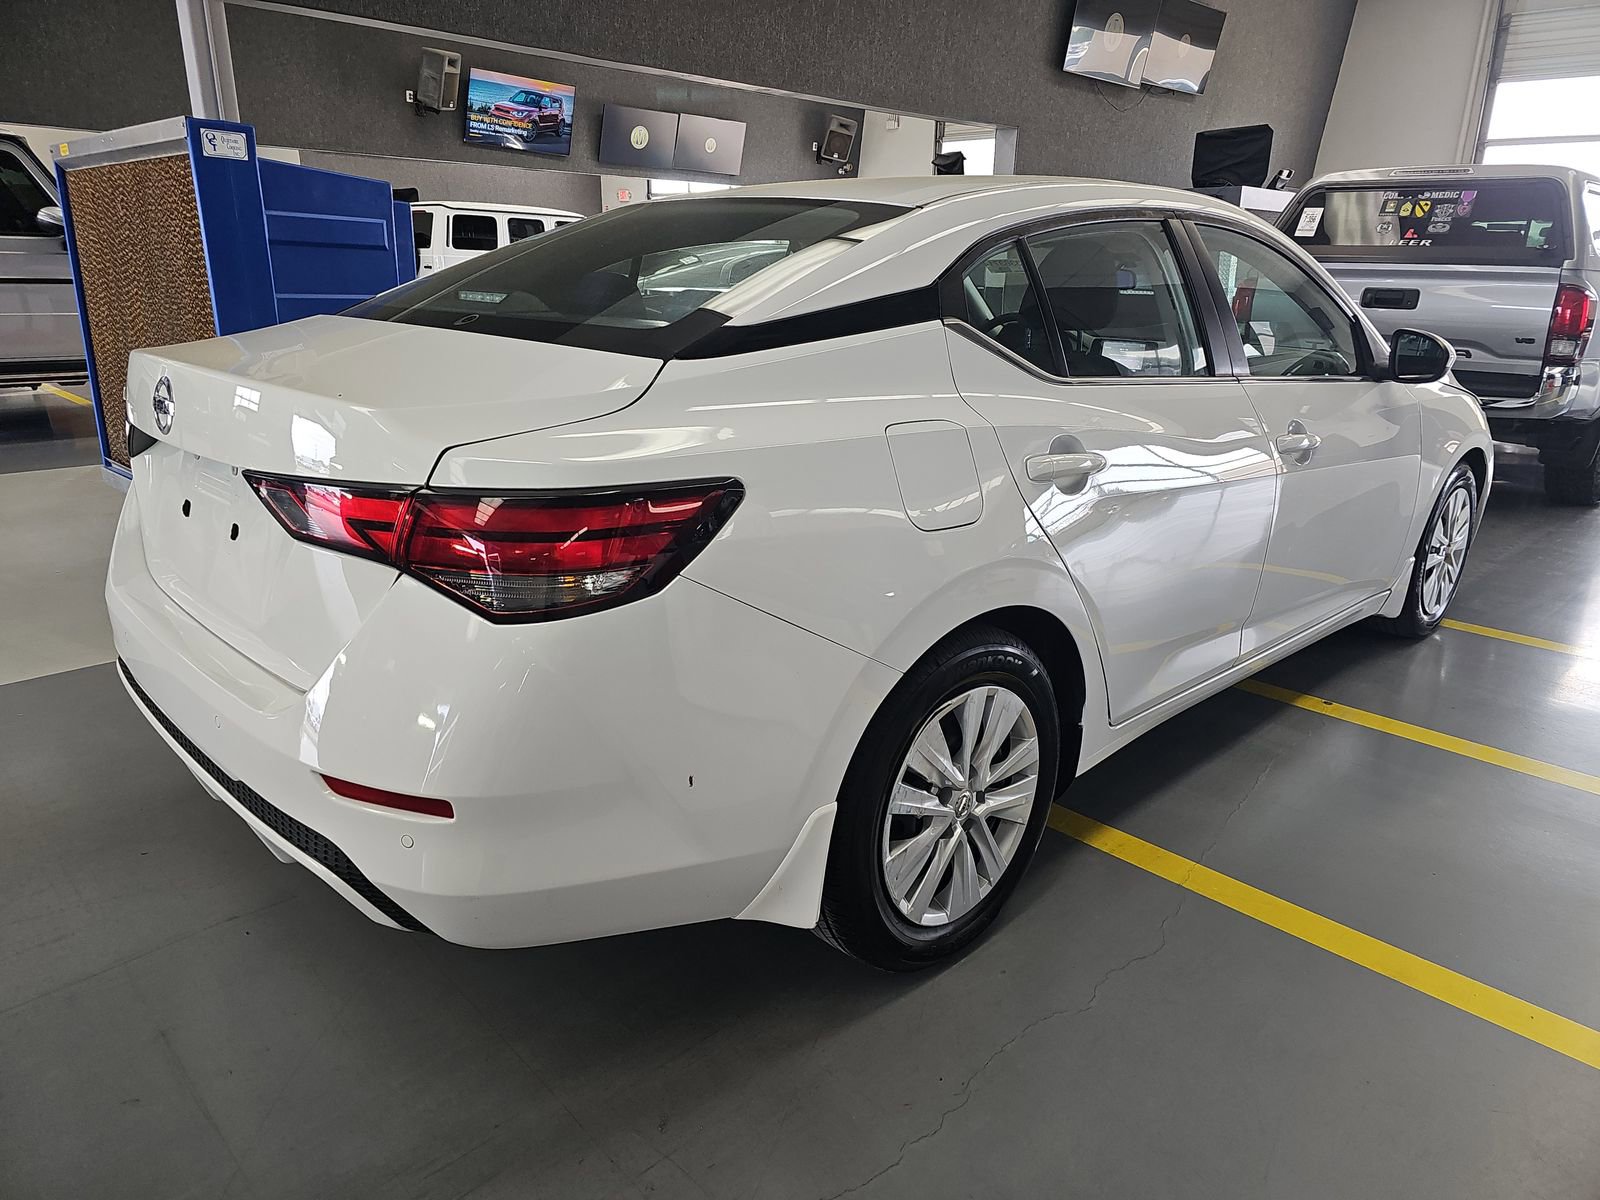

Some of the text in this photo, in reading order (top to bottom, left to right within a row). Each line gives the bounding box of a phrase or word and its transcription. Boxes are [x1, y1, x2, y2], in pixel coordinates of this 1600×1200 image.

[499, 119, 532, 128] CONFIDENCE
[495, 126, 527, 136] Remarketing
[1431, 191, 1460, 199] MEDIC
[1389, 239, 1433, 247] LEER
